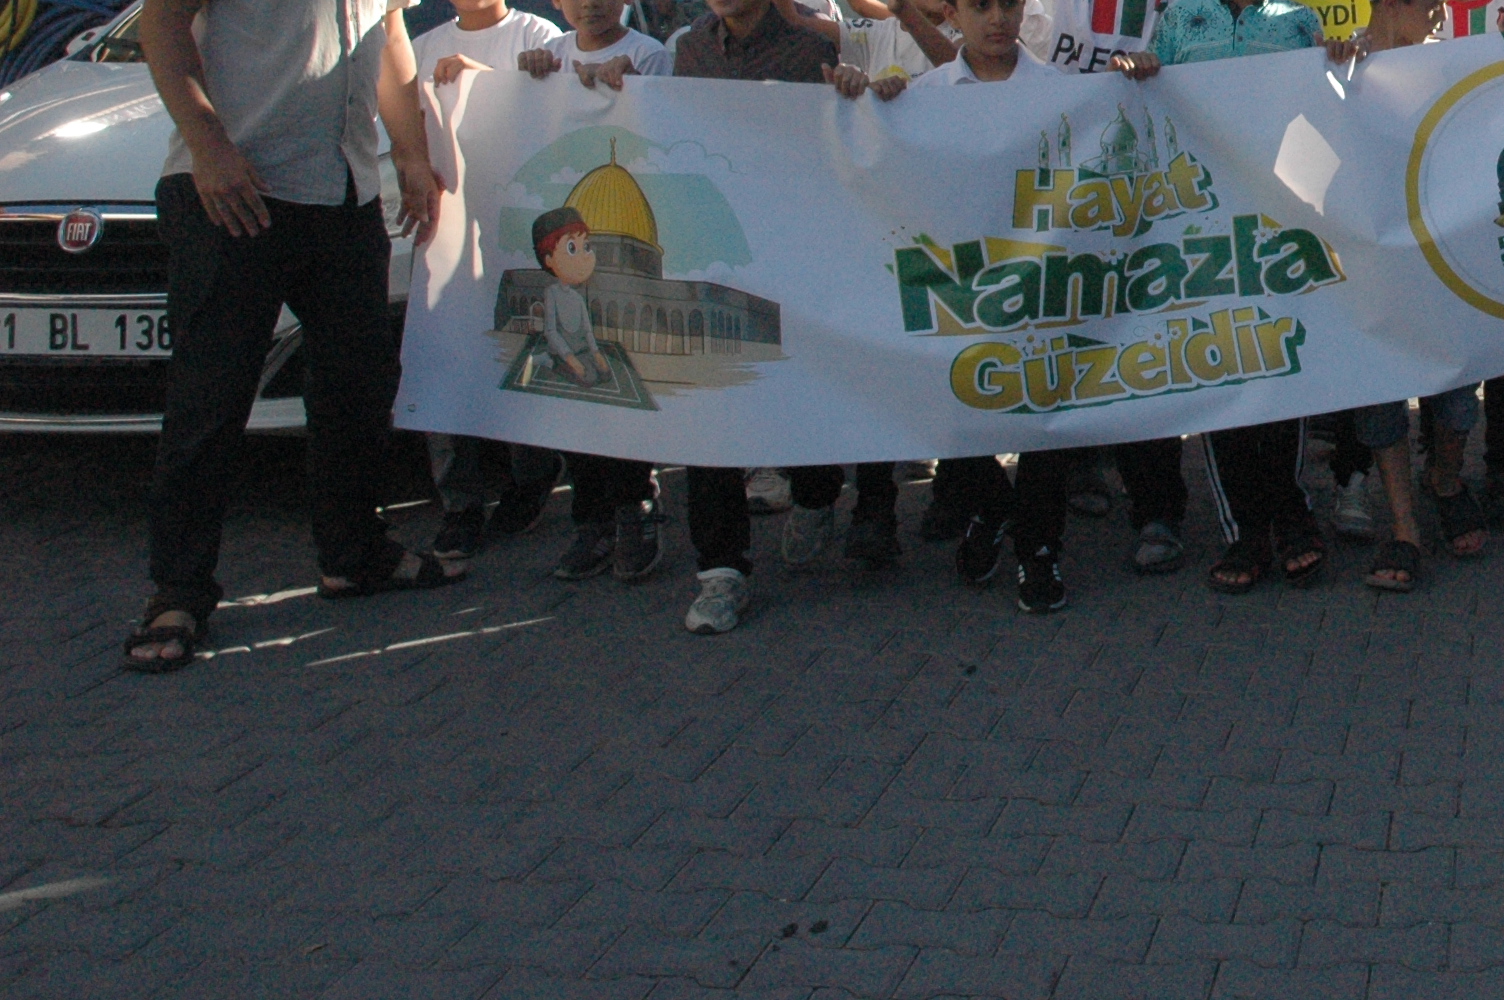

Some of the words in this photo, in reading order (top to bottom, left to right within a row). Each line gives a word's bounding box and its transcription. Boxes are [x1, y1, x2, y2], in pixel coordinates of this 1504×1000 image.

[1317, 0, 1357, 26] YDİ
[1012, 150, 1217, 239] Hayat
[66, 222, 93, 241] FIAT
[894, 213, 1342, 335] Namazla
[50, 313, 90, 350] BL
[949, 305, 1303, 413] Güzeldir
